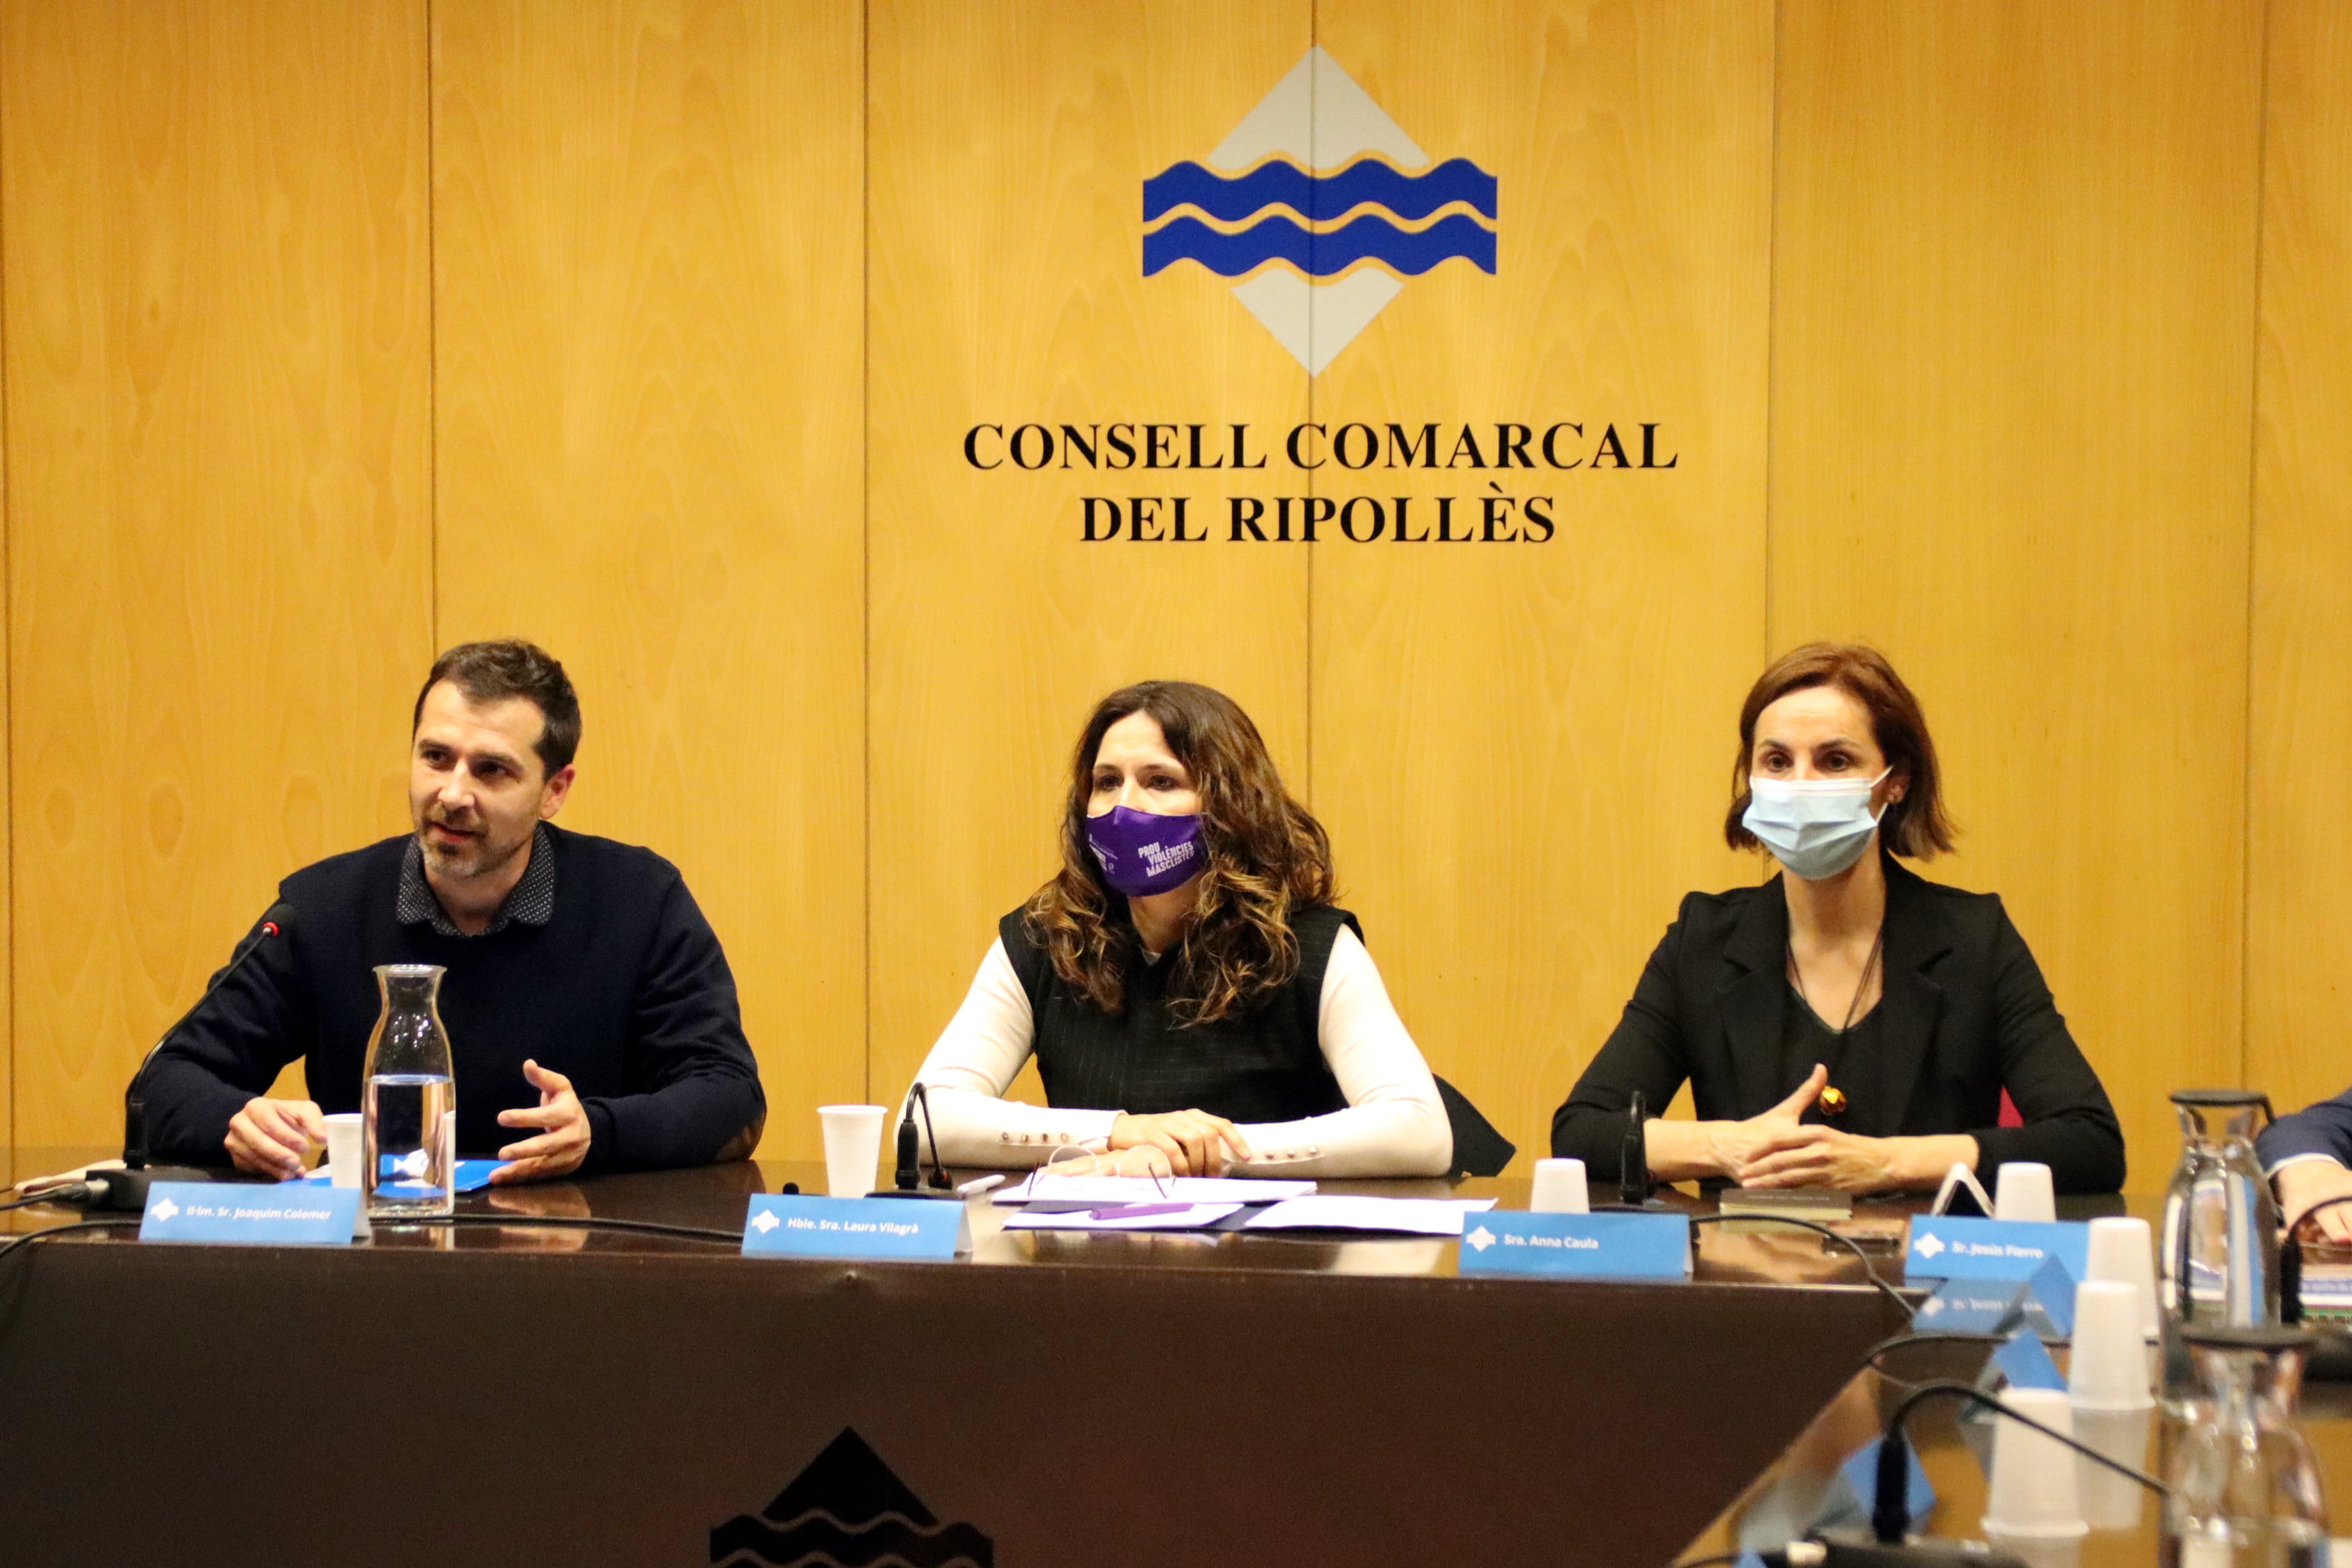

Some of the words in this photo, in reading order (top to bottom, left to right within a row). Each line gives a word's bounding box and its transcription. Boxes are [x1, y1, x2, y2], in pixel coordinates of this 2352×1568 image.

[965, 423, 1267, 470] CONSELL
[1286, 423, 1678, 470] COMARCAL
[1081, 498, 1208, 542] DEL
[1227, 480, 1553, 543] RIPOLLÈS
[1138, 842, 1160, 858] PROU
[1147, 841, 1194, 865] VIOLÈNCIES
[1146, 850, 1194, 877] MASCLISTES
[217, 1206, 231, 1217] Sr.
[233, 1207, 281, 1220] Joaquim
[284, 1208, 331, 1219] Colomer
[788, 1218, 816, 1229] Hble.
[819, 1219, 841, 1231] Sra.
[843, 1221, 876, 1232] Laura
[879, 1223, 919, 1236] Vilagrà
[1504, 1233, 1527, 1246] Sra.
[1529, 1234, 1562, 1248] Anna
[1564, 1237, 1599, 1249] Caula
[1952, 1240, 1969, 1254] Sr.
